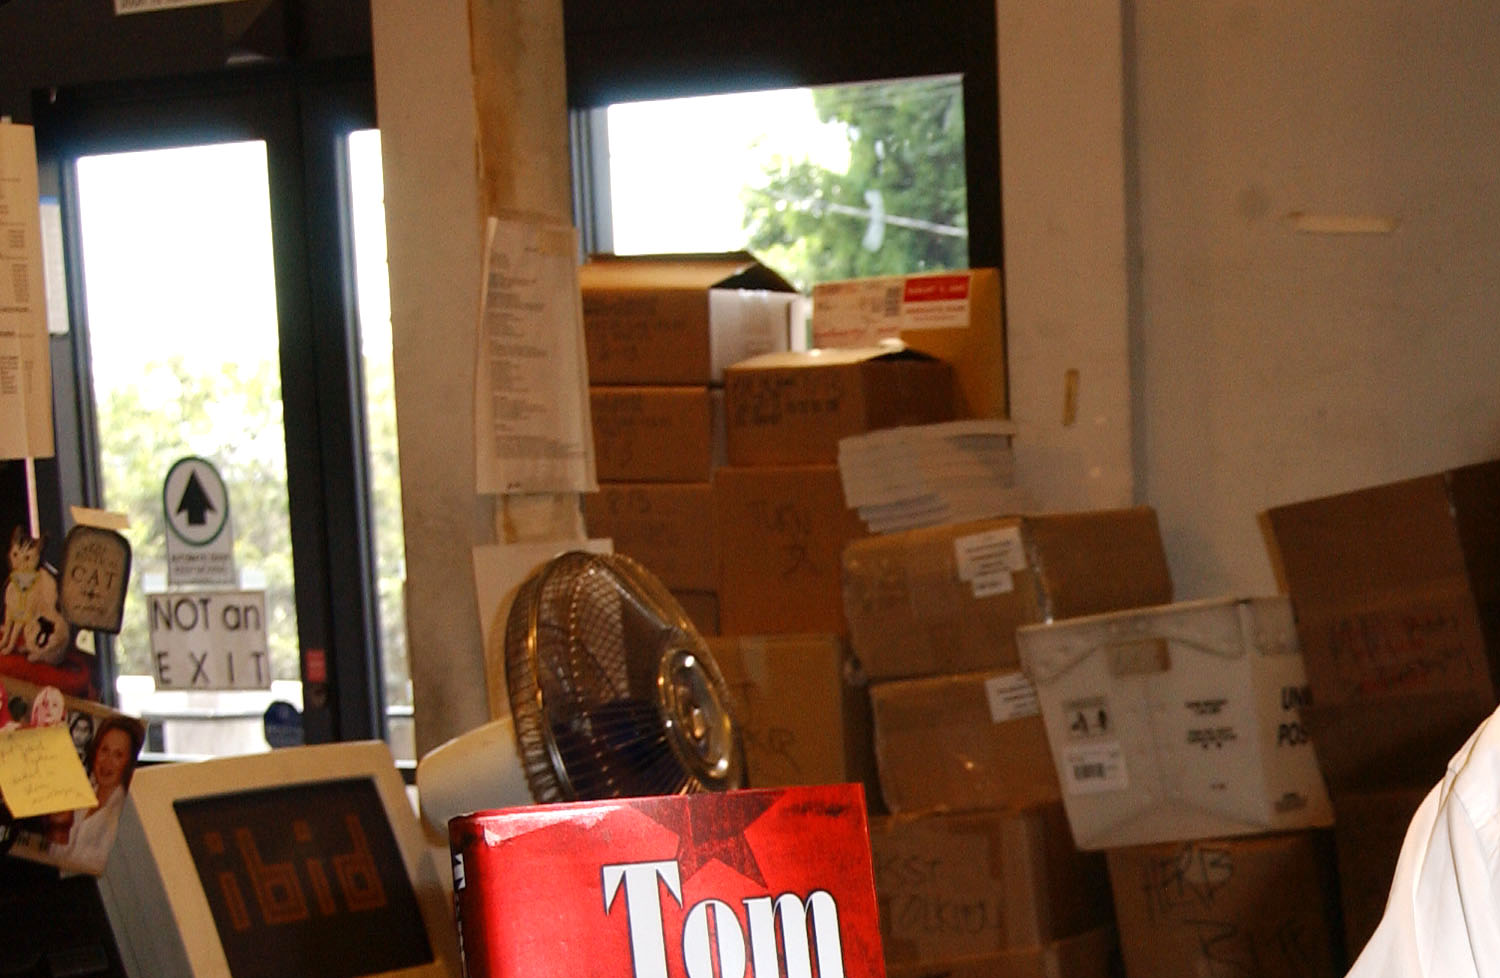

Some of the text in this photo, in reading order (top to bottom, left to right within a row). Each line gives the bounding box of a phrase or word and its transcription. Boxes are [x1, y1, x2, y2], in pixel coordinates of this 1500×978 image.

[153, 598, 261, 632] NOT an
[157, 651, 265, 685] EXIT
[203, 815, 387, 932] ibid
